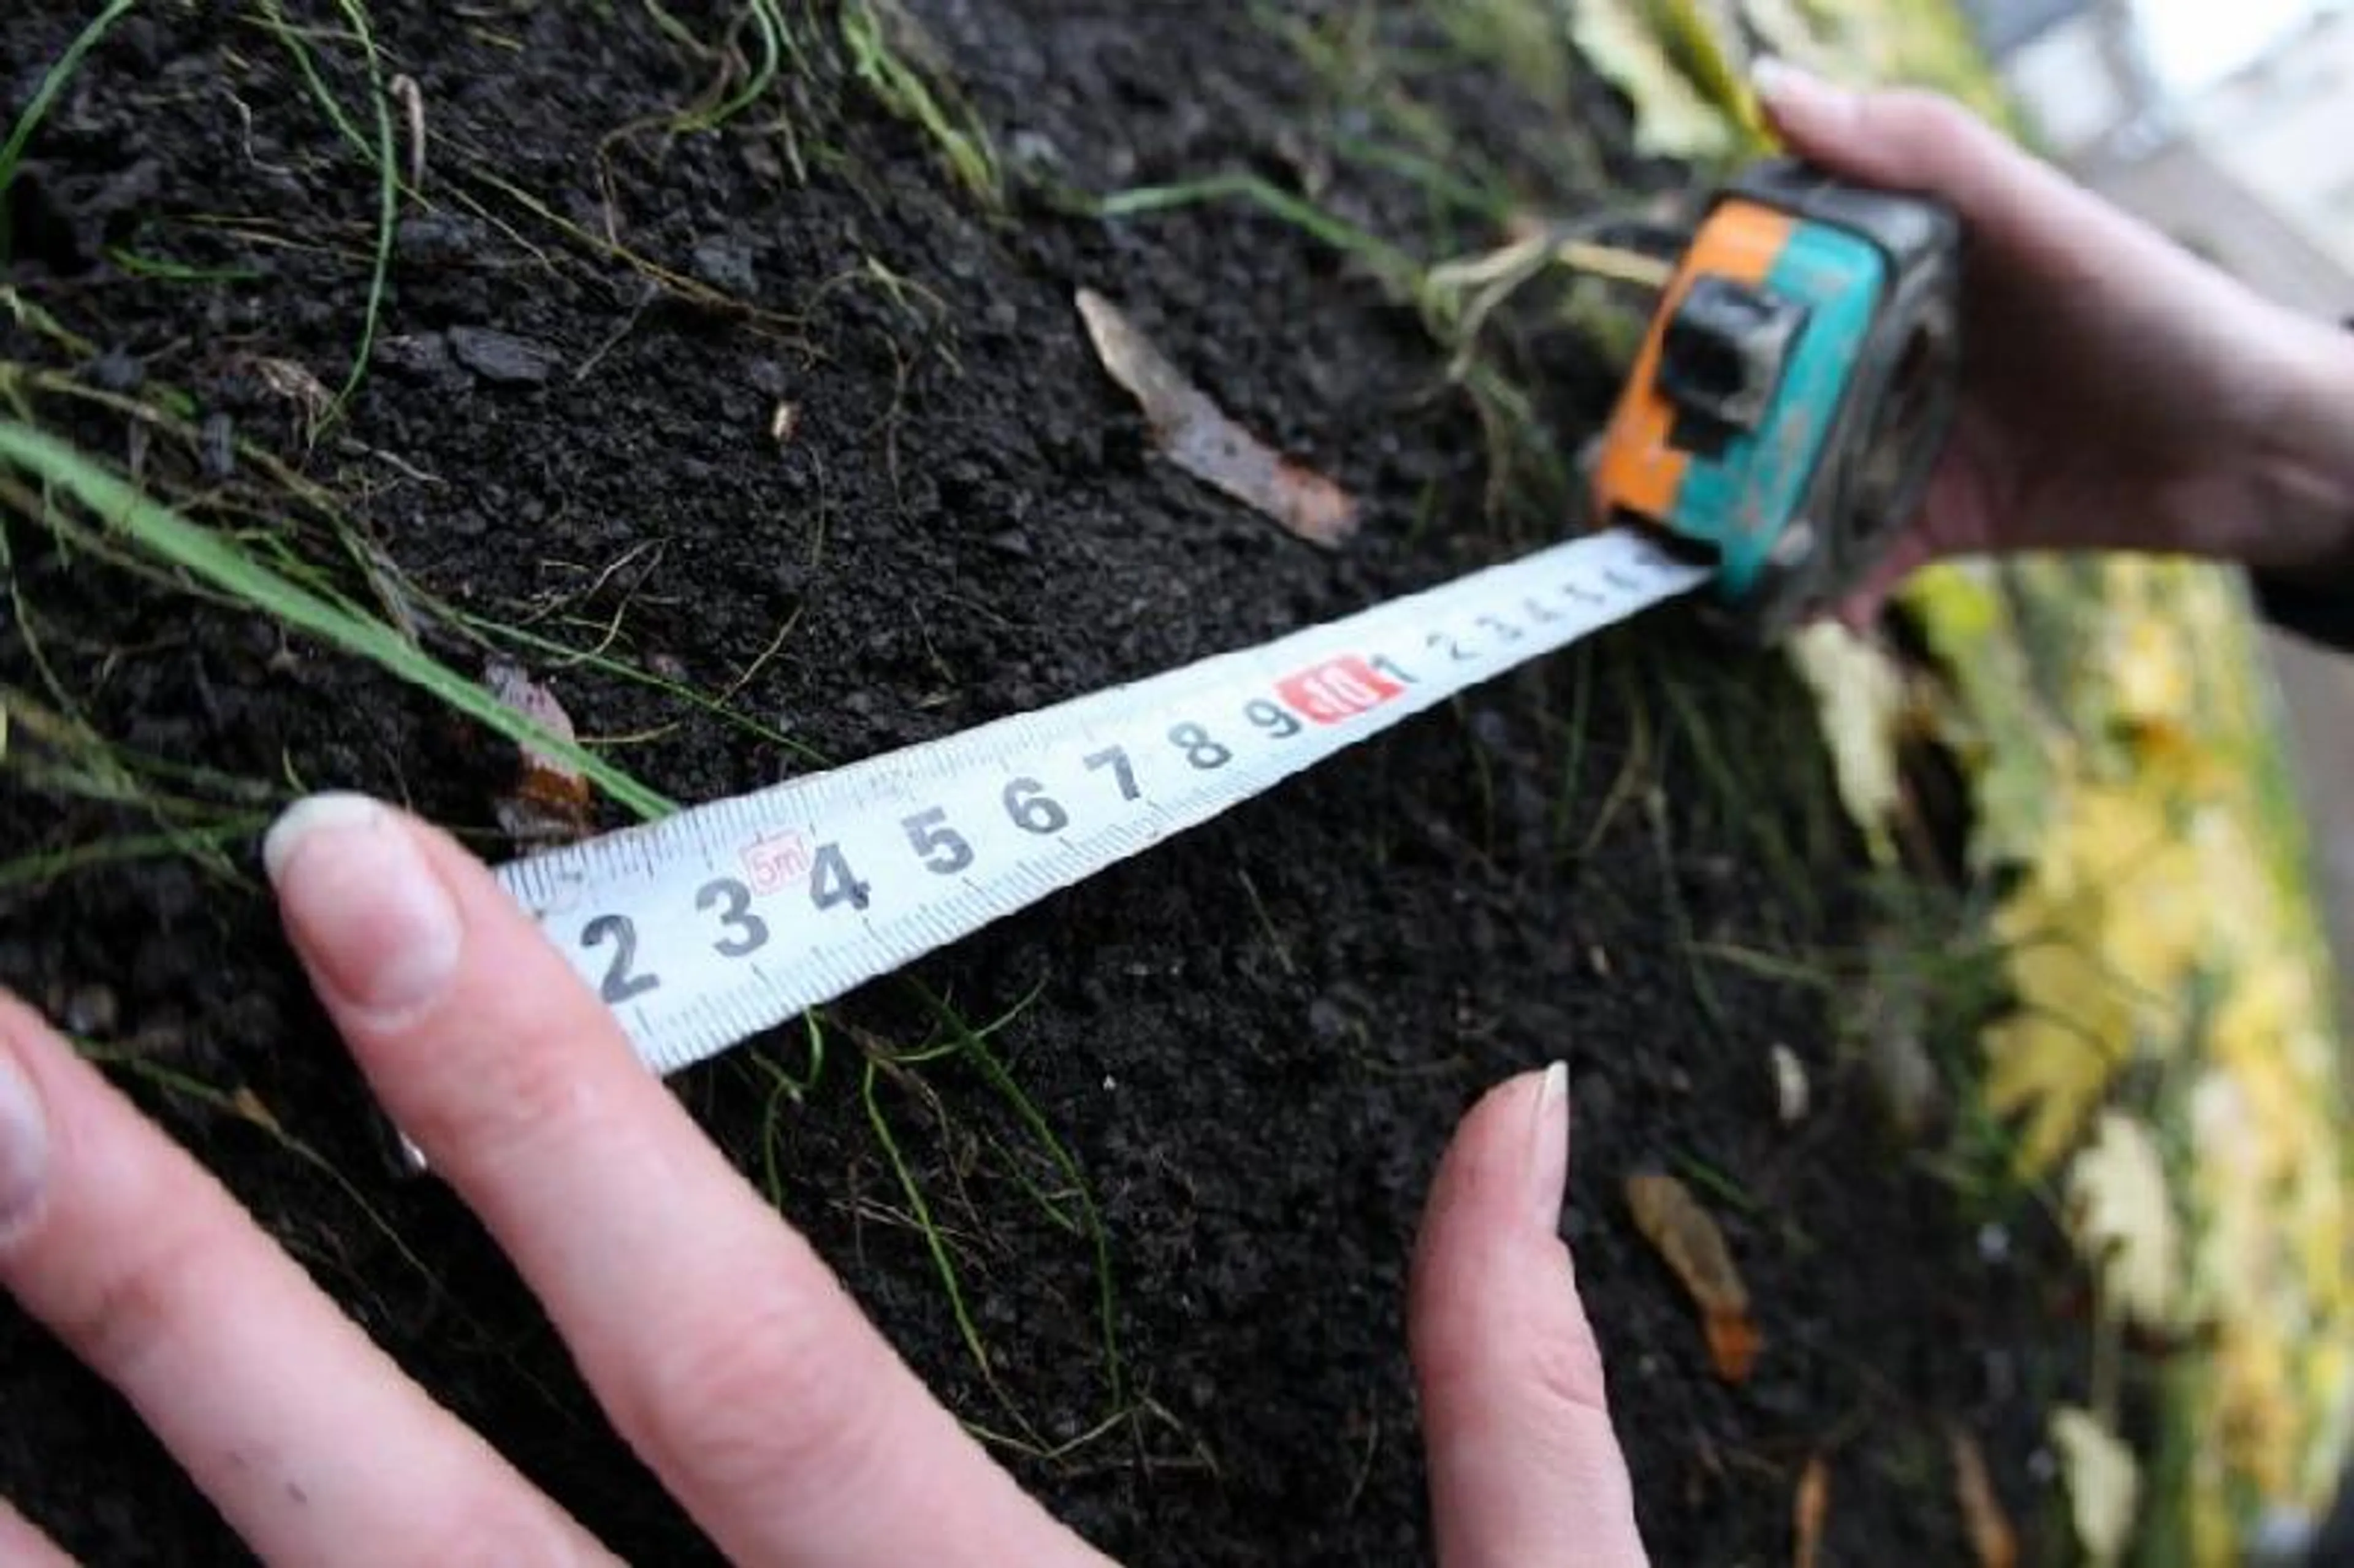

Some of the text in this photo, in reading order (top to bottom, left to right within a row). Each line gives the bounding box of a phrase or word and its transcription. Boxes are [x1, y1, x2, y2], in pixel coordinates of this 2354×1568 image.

[581, 914, 660, 1004] 2
[696, 877, 770, 957] 3
[809, 842, 871, 910] 4
[901, 807, 975, 875] 5
[1002, 777, 1069, 834] 6
[1083, 744, 1141, 801] 7
[1168, 721, 1232, 769] 8
[1243, 699, 1301, 739] 9
[1369, 653, 1420, 683] 1
[1425, 632, 1482, 661] 2
[749, 845, 808, 887] 5m
